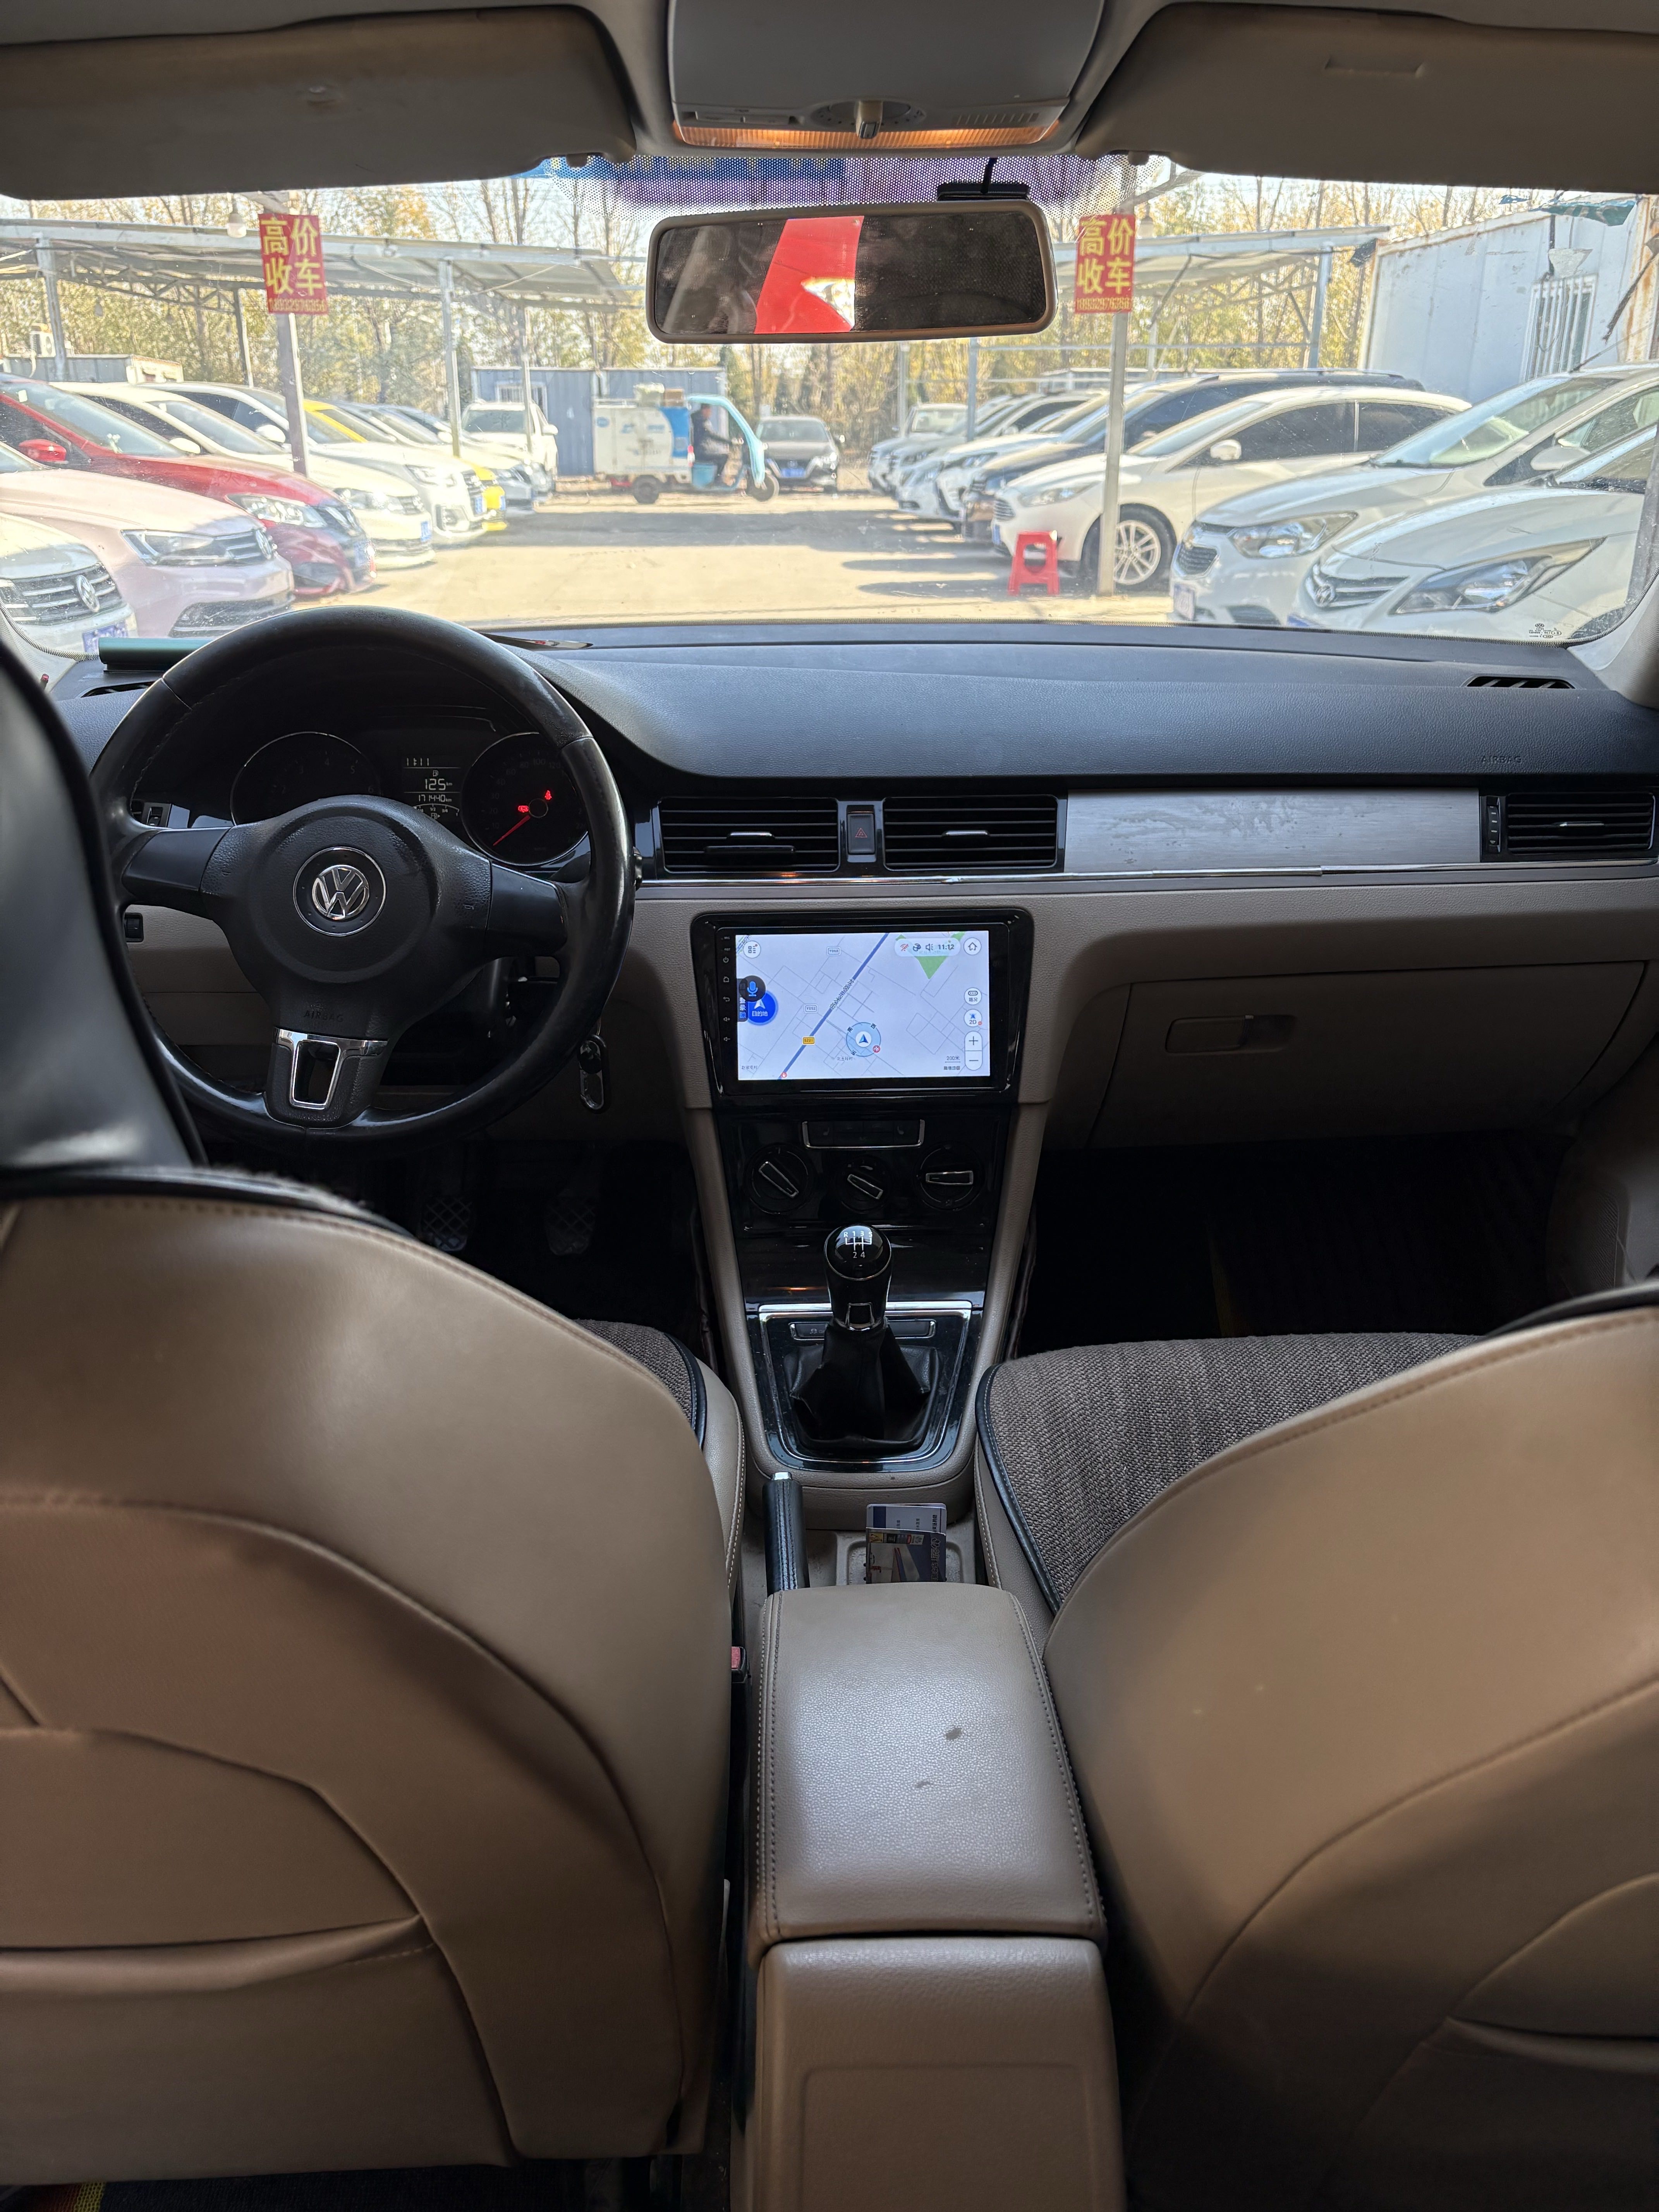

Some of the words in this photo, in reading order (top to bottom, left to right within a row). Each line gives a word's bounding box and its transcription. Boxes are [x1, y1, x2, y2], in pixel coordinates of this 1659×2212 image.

[261, 217, 318, 256] 高价
[1080, 217, 1133, 256] 高价
[265, 258, 323, 296] 收车
[1077, 257, 1132, 294] 收车
[425, 778, 446, 790] 125
